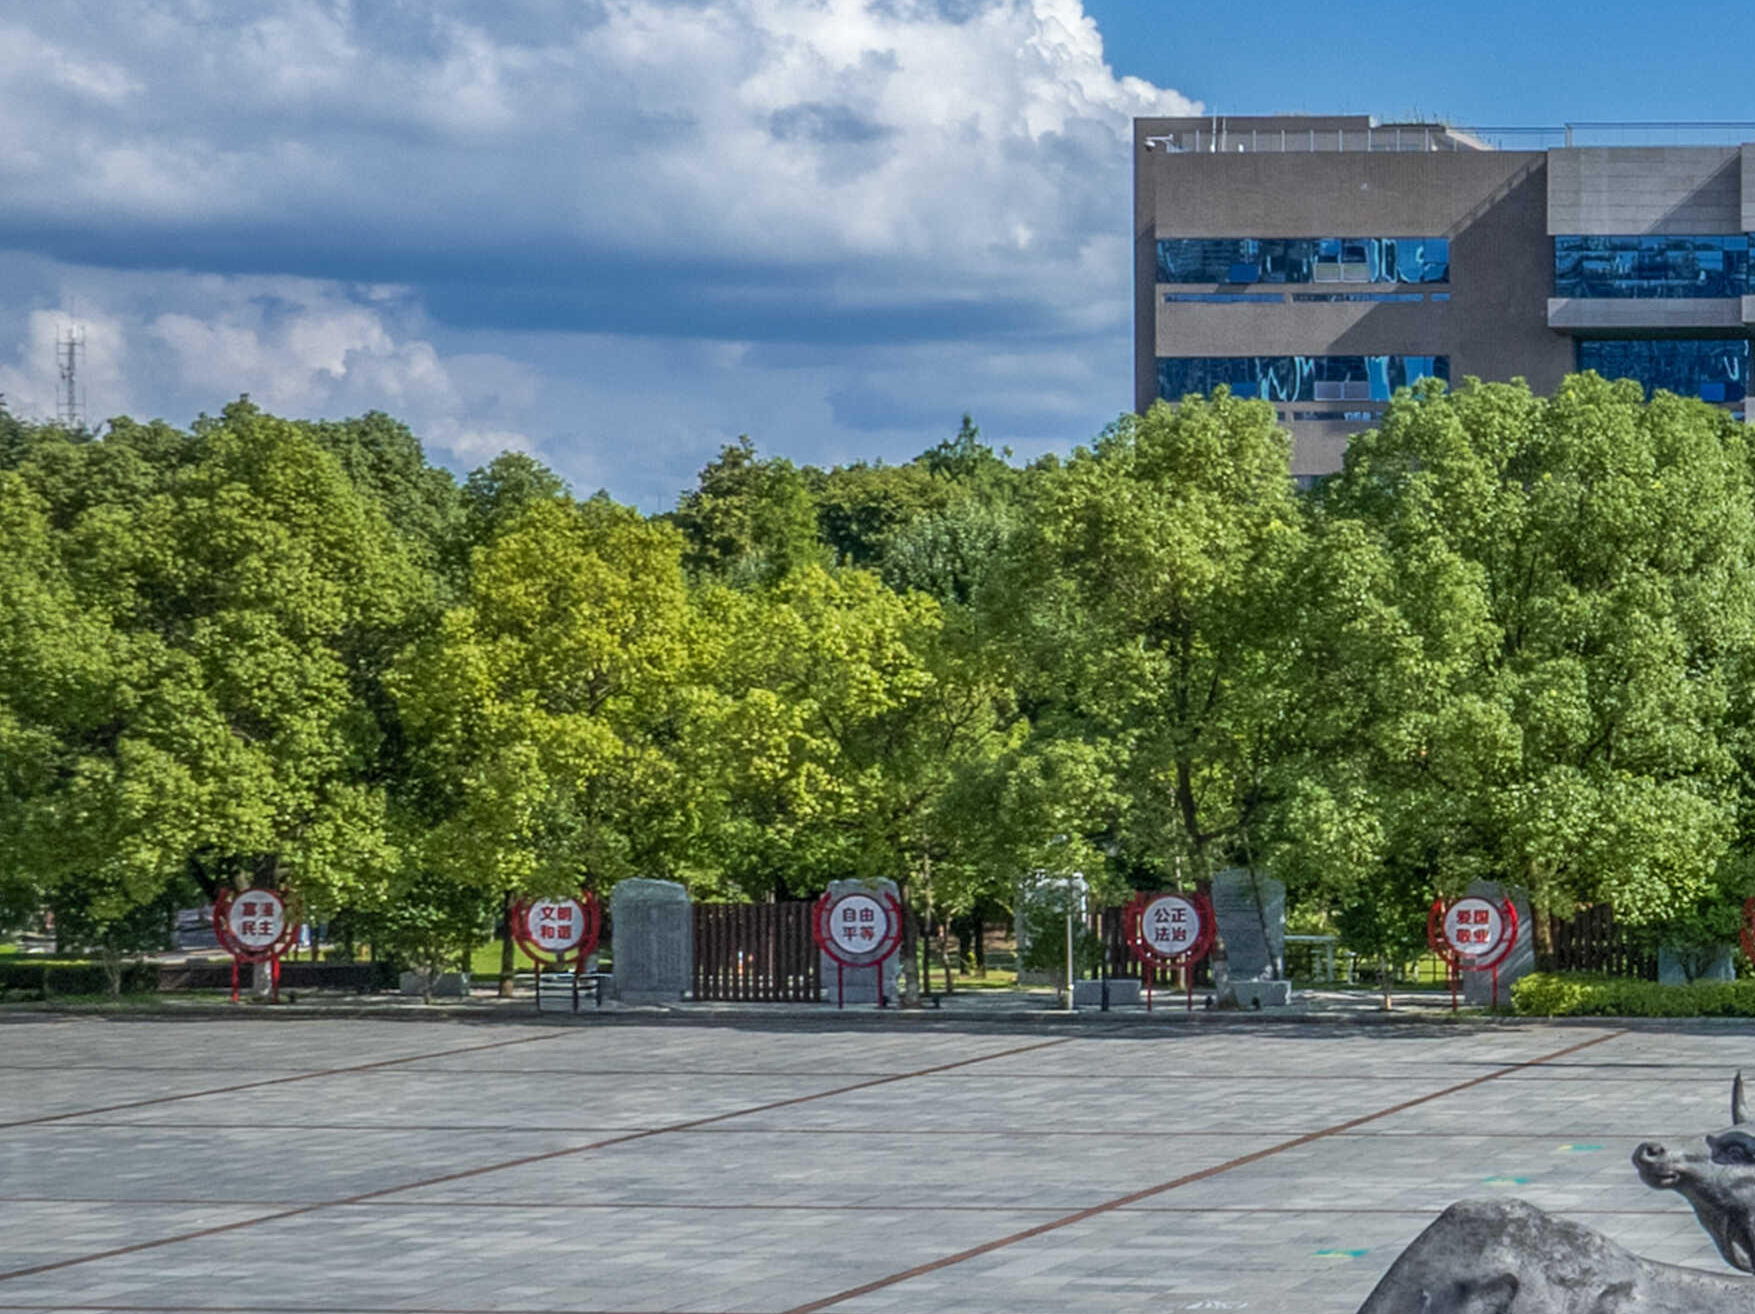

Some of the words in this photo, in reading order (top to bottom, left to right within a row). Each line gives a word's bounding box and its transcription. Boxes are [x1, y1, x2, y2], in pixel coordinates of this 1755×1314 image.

[843, 906, 874, 922] 自由
[1154, 907, 1187, 923] 公正
[1456, 910, 1489, 924] 爱国
[242, 920, 274, 936] 民主
[842, 925, 874, 942] 平等
[1154, 926, 1187, 942] 法治
